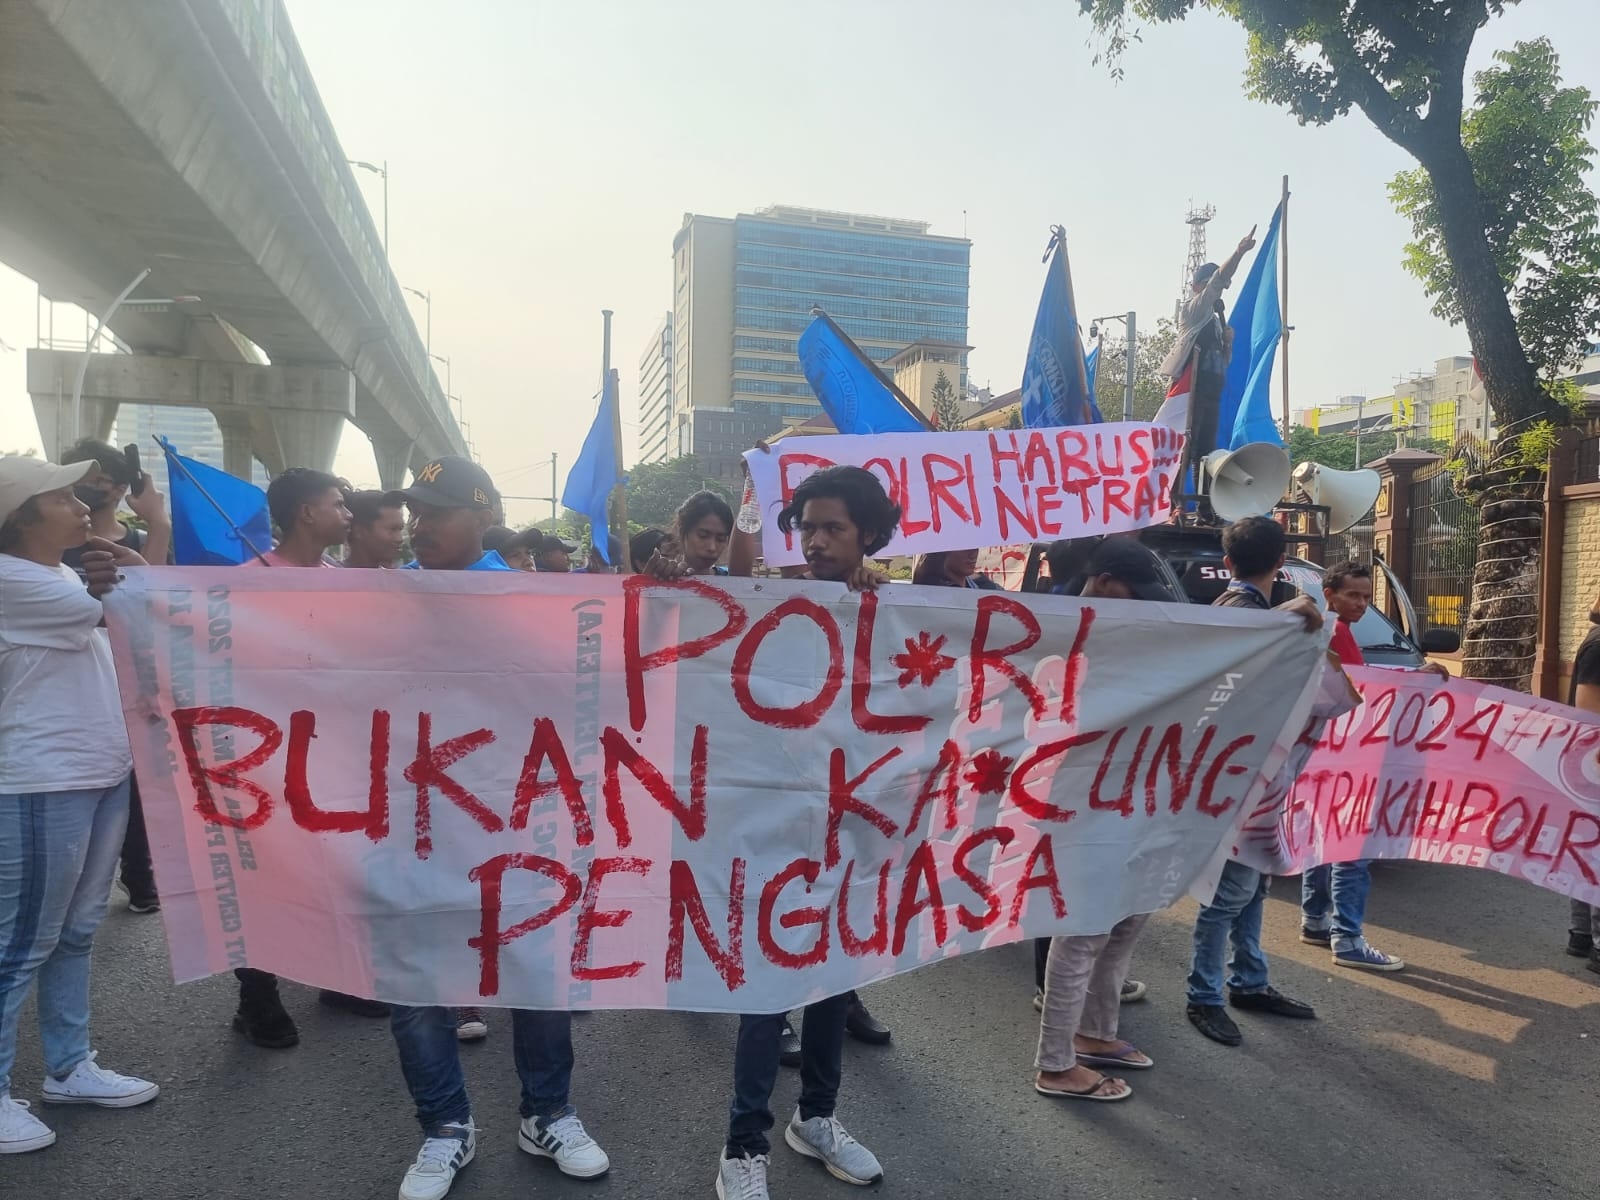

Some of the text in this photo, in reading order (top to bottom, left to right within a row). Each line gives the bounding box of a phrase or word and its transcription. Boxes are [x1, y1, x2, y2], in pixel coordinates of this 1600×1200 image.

[172, 706, 708, 859] BUKAN
[1360, 688, 1505, 760] 2024
[467, 825, 1068, 997] PENGUASA
